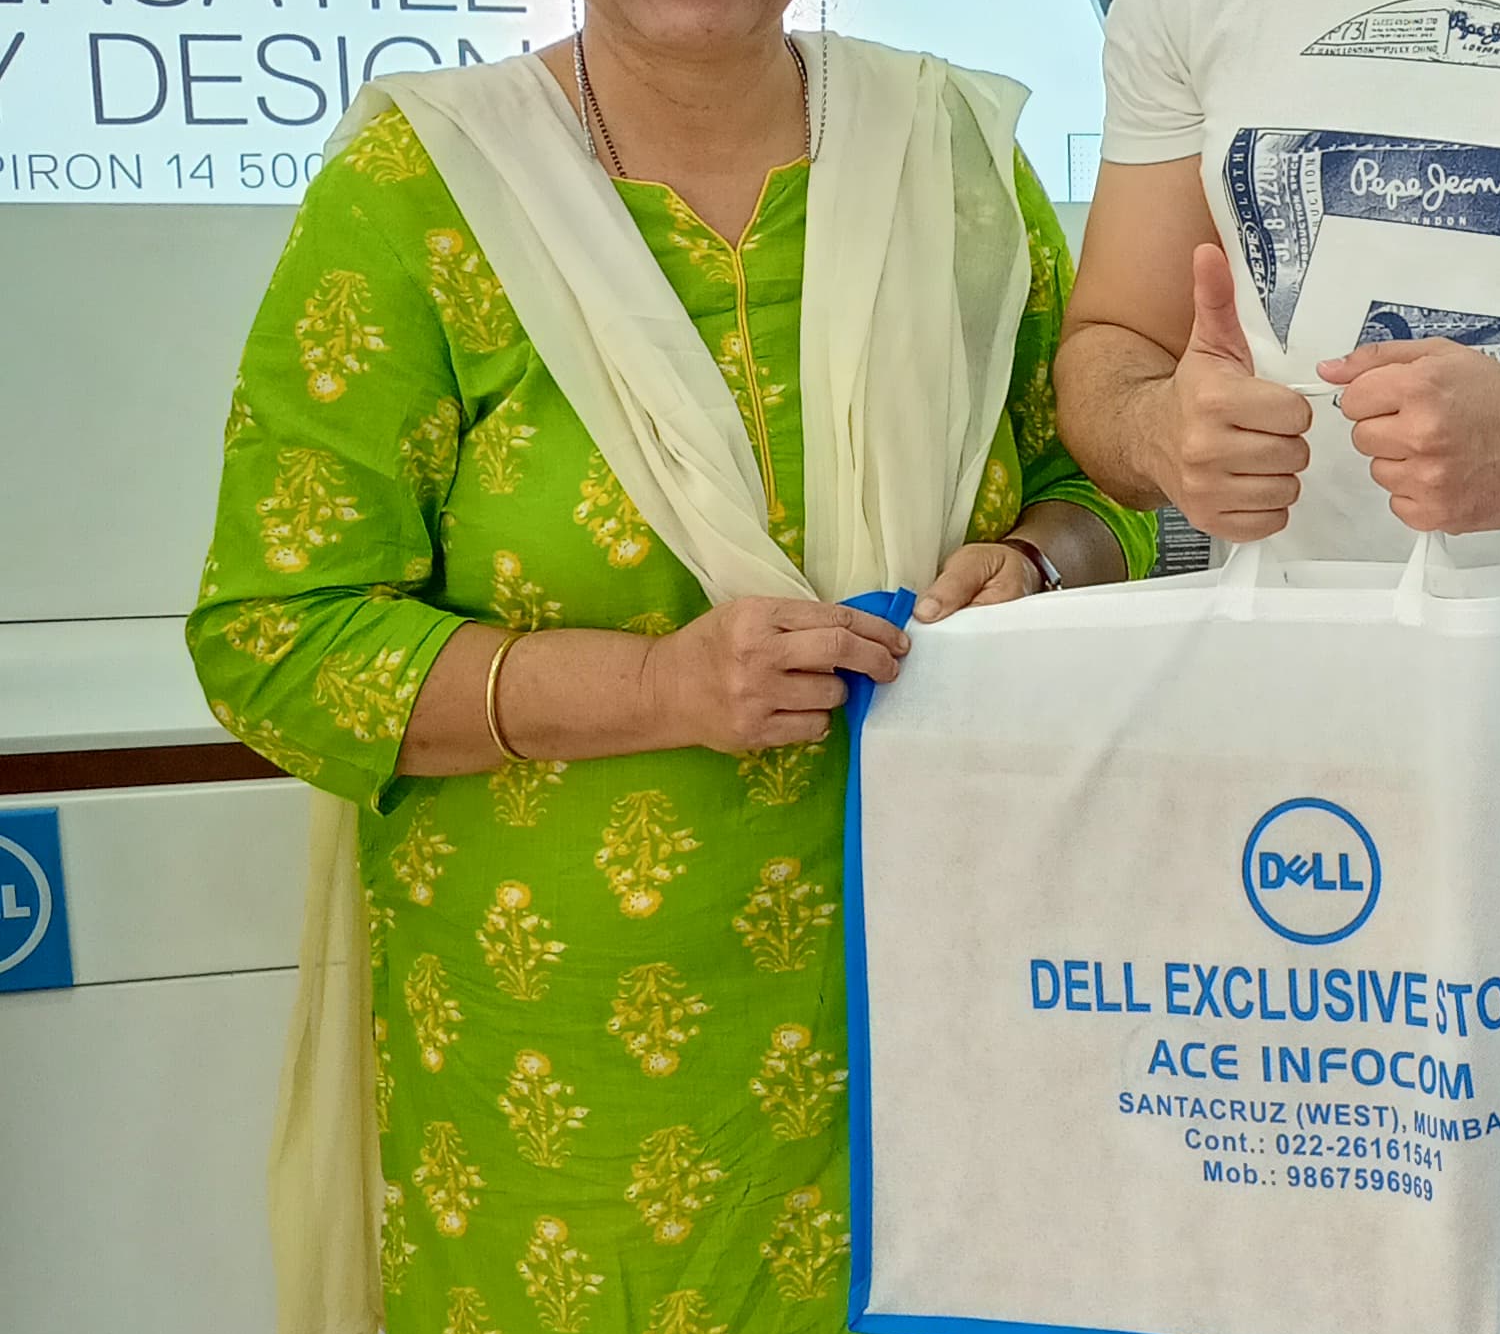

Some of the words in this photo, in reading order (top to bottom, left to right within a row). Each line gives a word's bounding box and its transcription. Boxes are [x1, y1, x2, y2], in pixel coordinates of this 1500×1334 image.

[89, 32, 530, 127] DESI
[0, 153, 143, 191] IRON
[166, 153, 215, 189] 14
[1351, 157, 1424, 211] Pepe
[1304, 157, 1321, 238] RUCTION
[1259, 852, 1364, 891] DELL
[1030, 959, 1152, 1013] DELL
[1164, 962, 1429, 1028] EXCLUSIVE
[1147, 1039, 1239, 1081] ACE
[1262, 1045, 1475, 1101] INFOCOM
[1118, 1091, 1287, 1125] SANTACRUZ
[1295, 1101, 1408, 1135] (WEST),
[1184, 1128, 1266, 1156] Cont.:
[1275, 1133, 1443, 1172] 022-26161541
[1202, 1160, 1277, 1187] Mob.:
[1286, 1165, 1434, 1202] 9867596969
